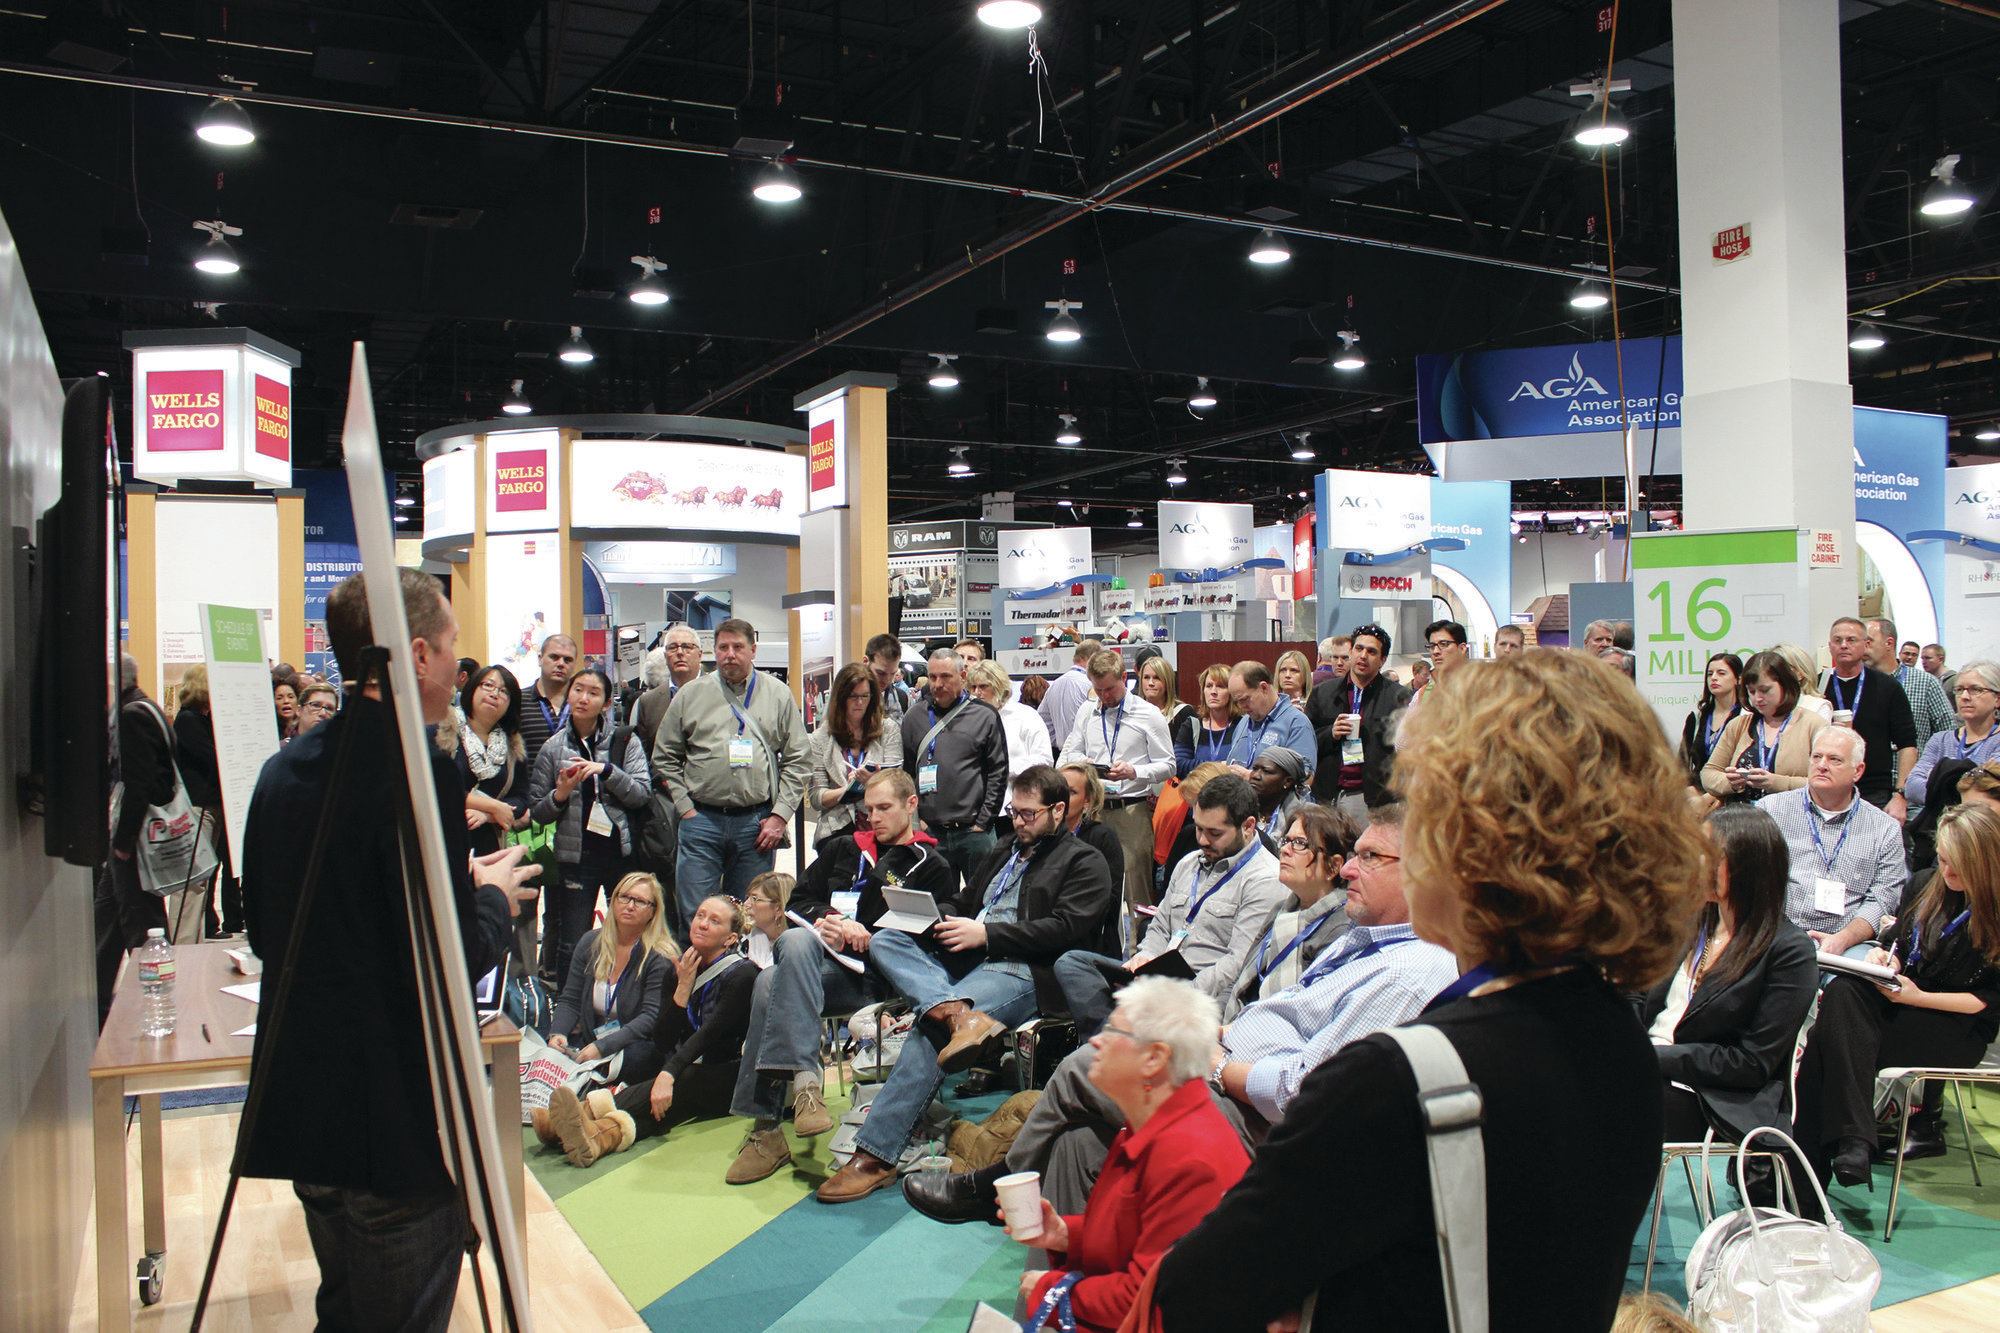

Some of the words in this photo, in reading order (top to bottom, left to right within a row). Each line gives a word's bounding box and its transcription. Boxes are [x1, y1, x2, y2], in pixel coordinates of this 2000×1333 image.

[1720, 229, 1742, 245] FIRE
[1720, 241, 1743, 256] HOSE
[1508, 376, 1608, 401] AGA
[150, 392, 220, 409] WELLS
[1567, 396, 1659, 412] American
[256, 396, 288, 421] WELLS
[152, 412, 220, 429] FARGO
[1568, 410, 1680, 427] Association
[257, 416, 288, 439] FARGO
[811, 438, 834, 457] WELLS
[812, 455, 834, 474] FARGO
[497, 465, 545, 480] WELLS
[1897, 472, 1919, 486] Gas
[498, 481, 544, 495] FARGO
[911, 531, 951, 542] RAM
[1461, 524, 1483, 535] Gas
[1817, 532, 1833, 542] FIRE
[1815, 543, 1835, 553] HOSE
[1811, 554, 1841, 564] CABINET
[306, 562, 364, 572] DISTRIBUTO
[310, 575, 326, 583] and
[1369, 575, 1413, 592] BOSCH
[1011, 609, 1061, 620] Thermador
[1647, 577, 1732, 642] 16
